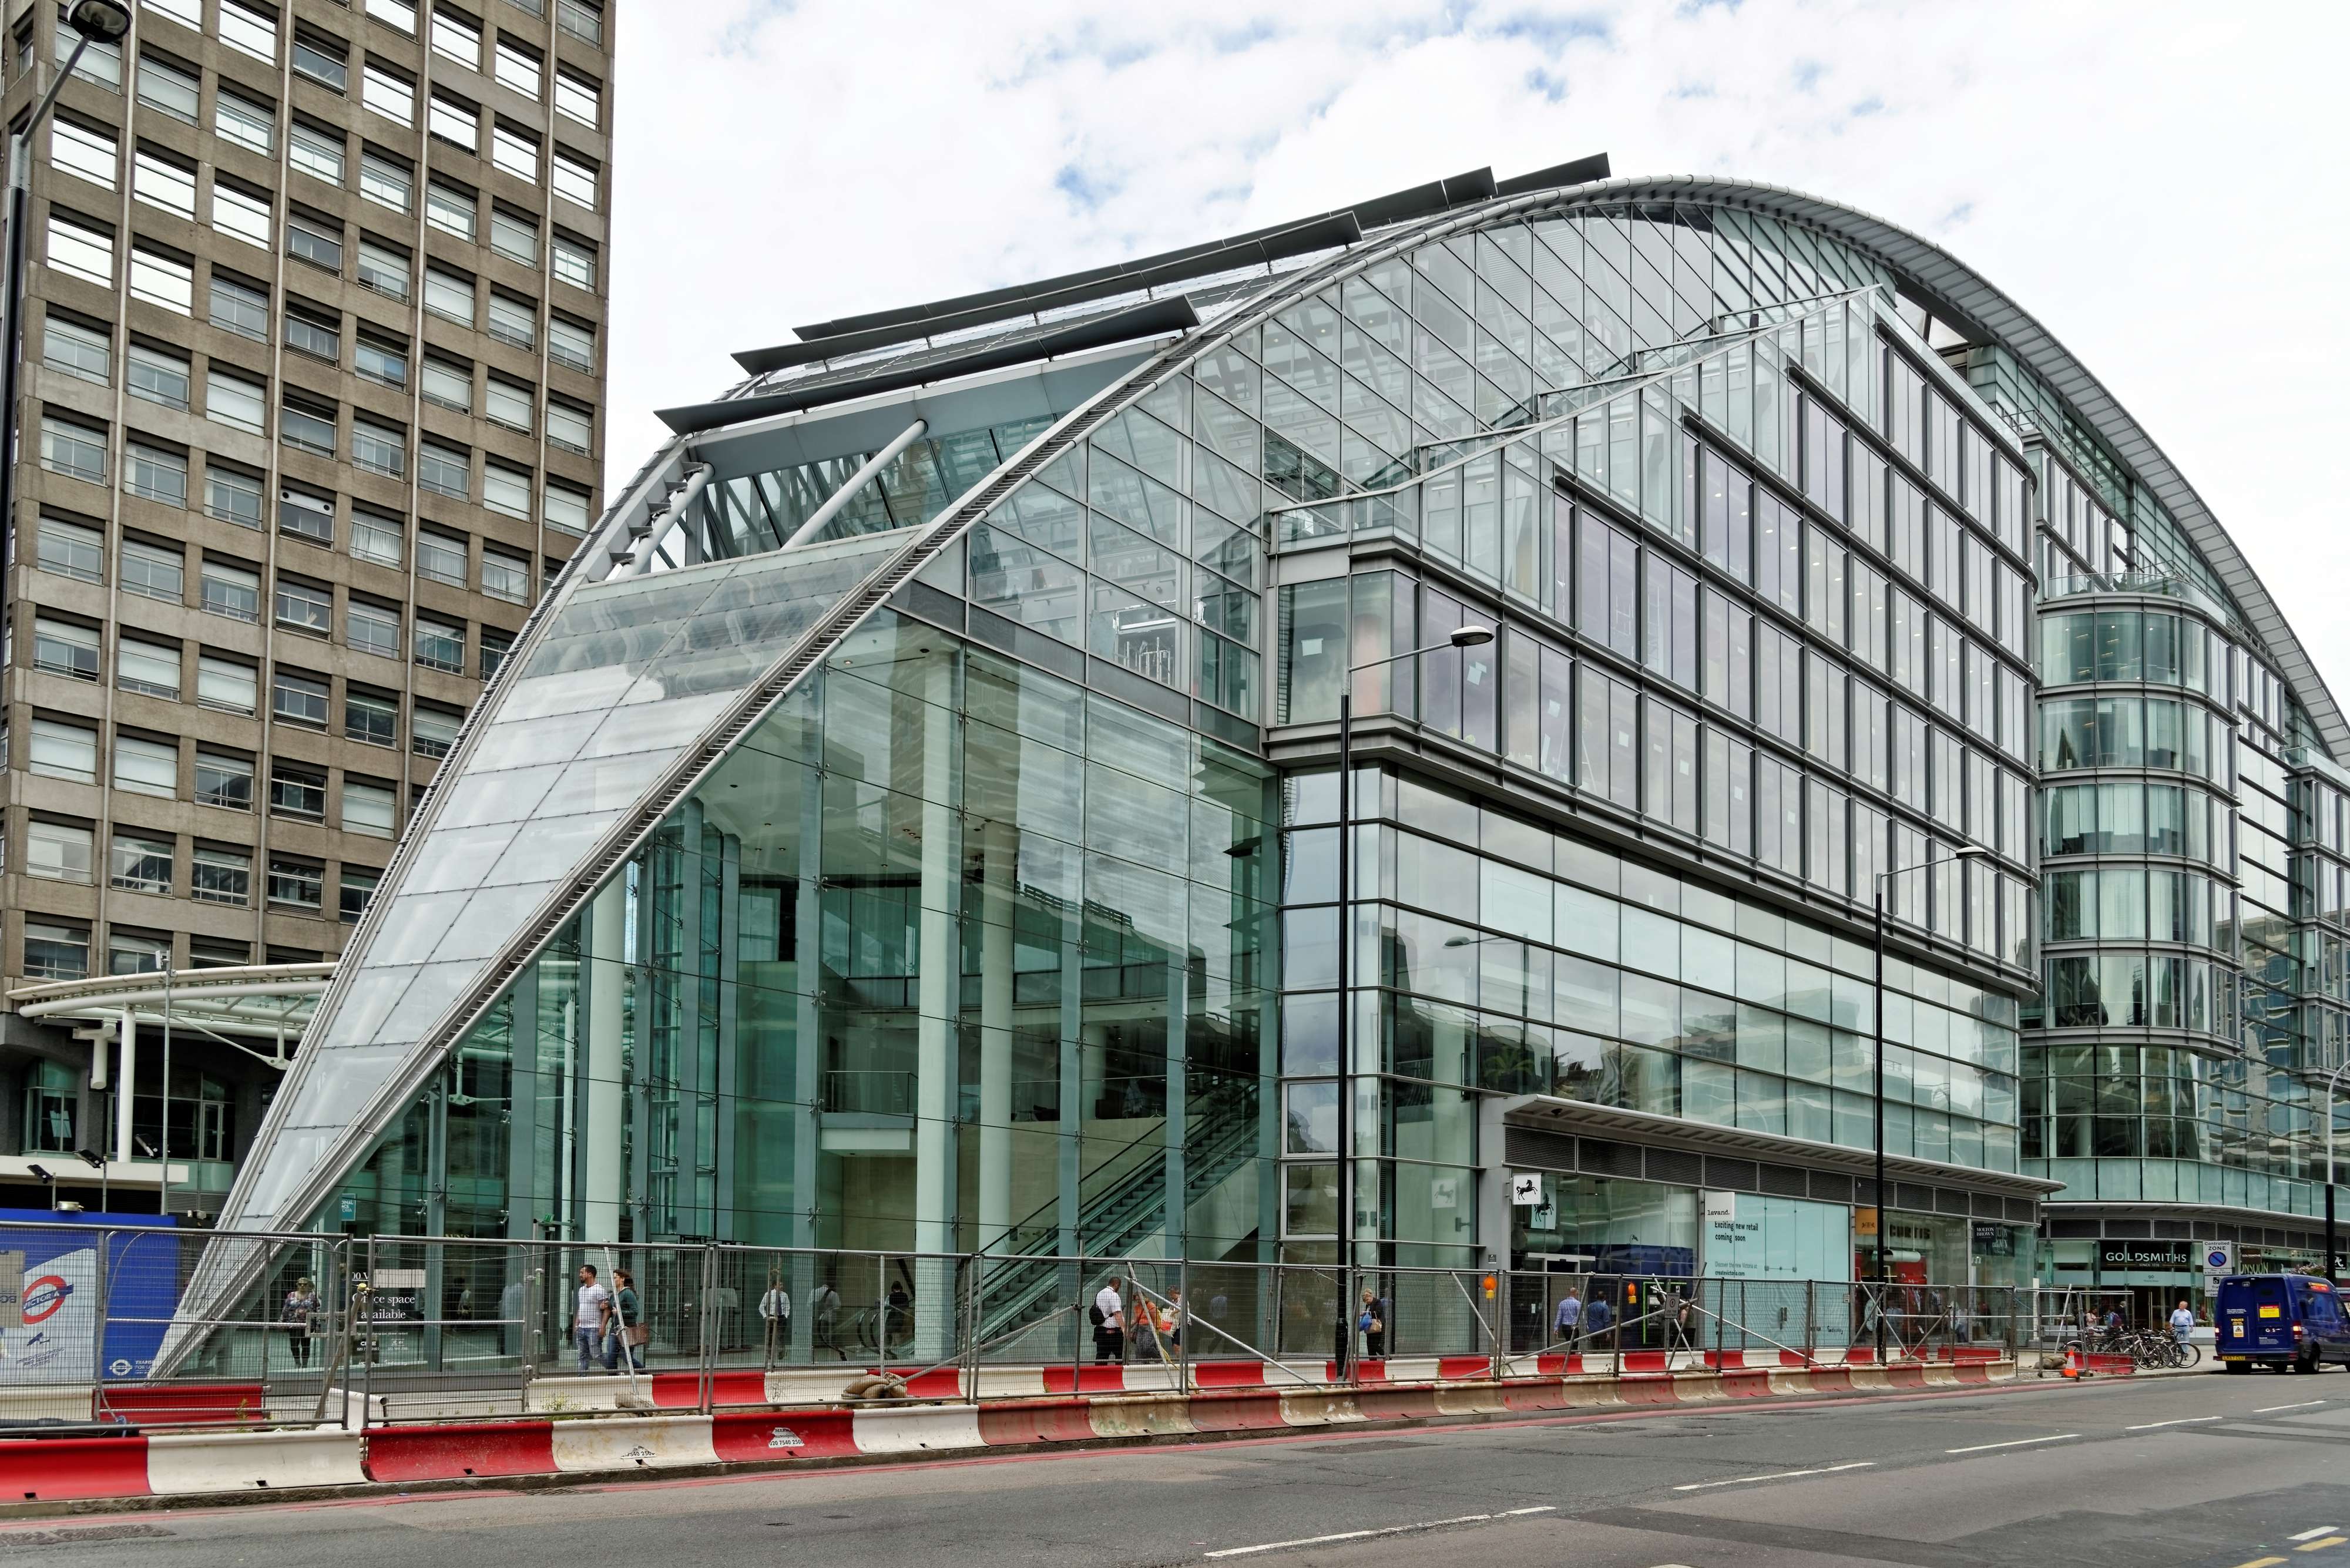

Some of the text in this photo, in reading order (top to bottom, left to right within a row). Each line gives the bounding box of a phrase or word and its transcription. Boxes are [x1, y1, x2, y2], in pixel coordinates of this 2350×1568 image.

[1715, 1221, 1734, 1231] Exciting
[1715, 1233, 1733, 1243] coming
[2106, 1253, 2187, 1263] GOLDSMITHS
[387, 1297, 415, 1306] space
[361, 1309, 406, 1319] aailable
